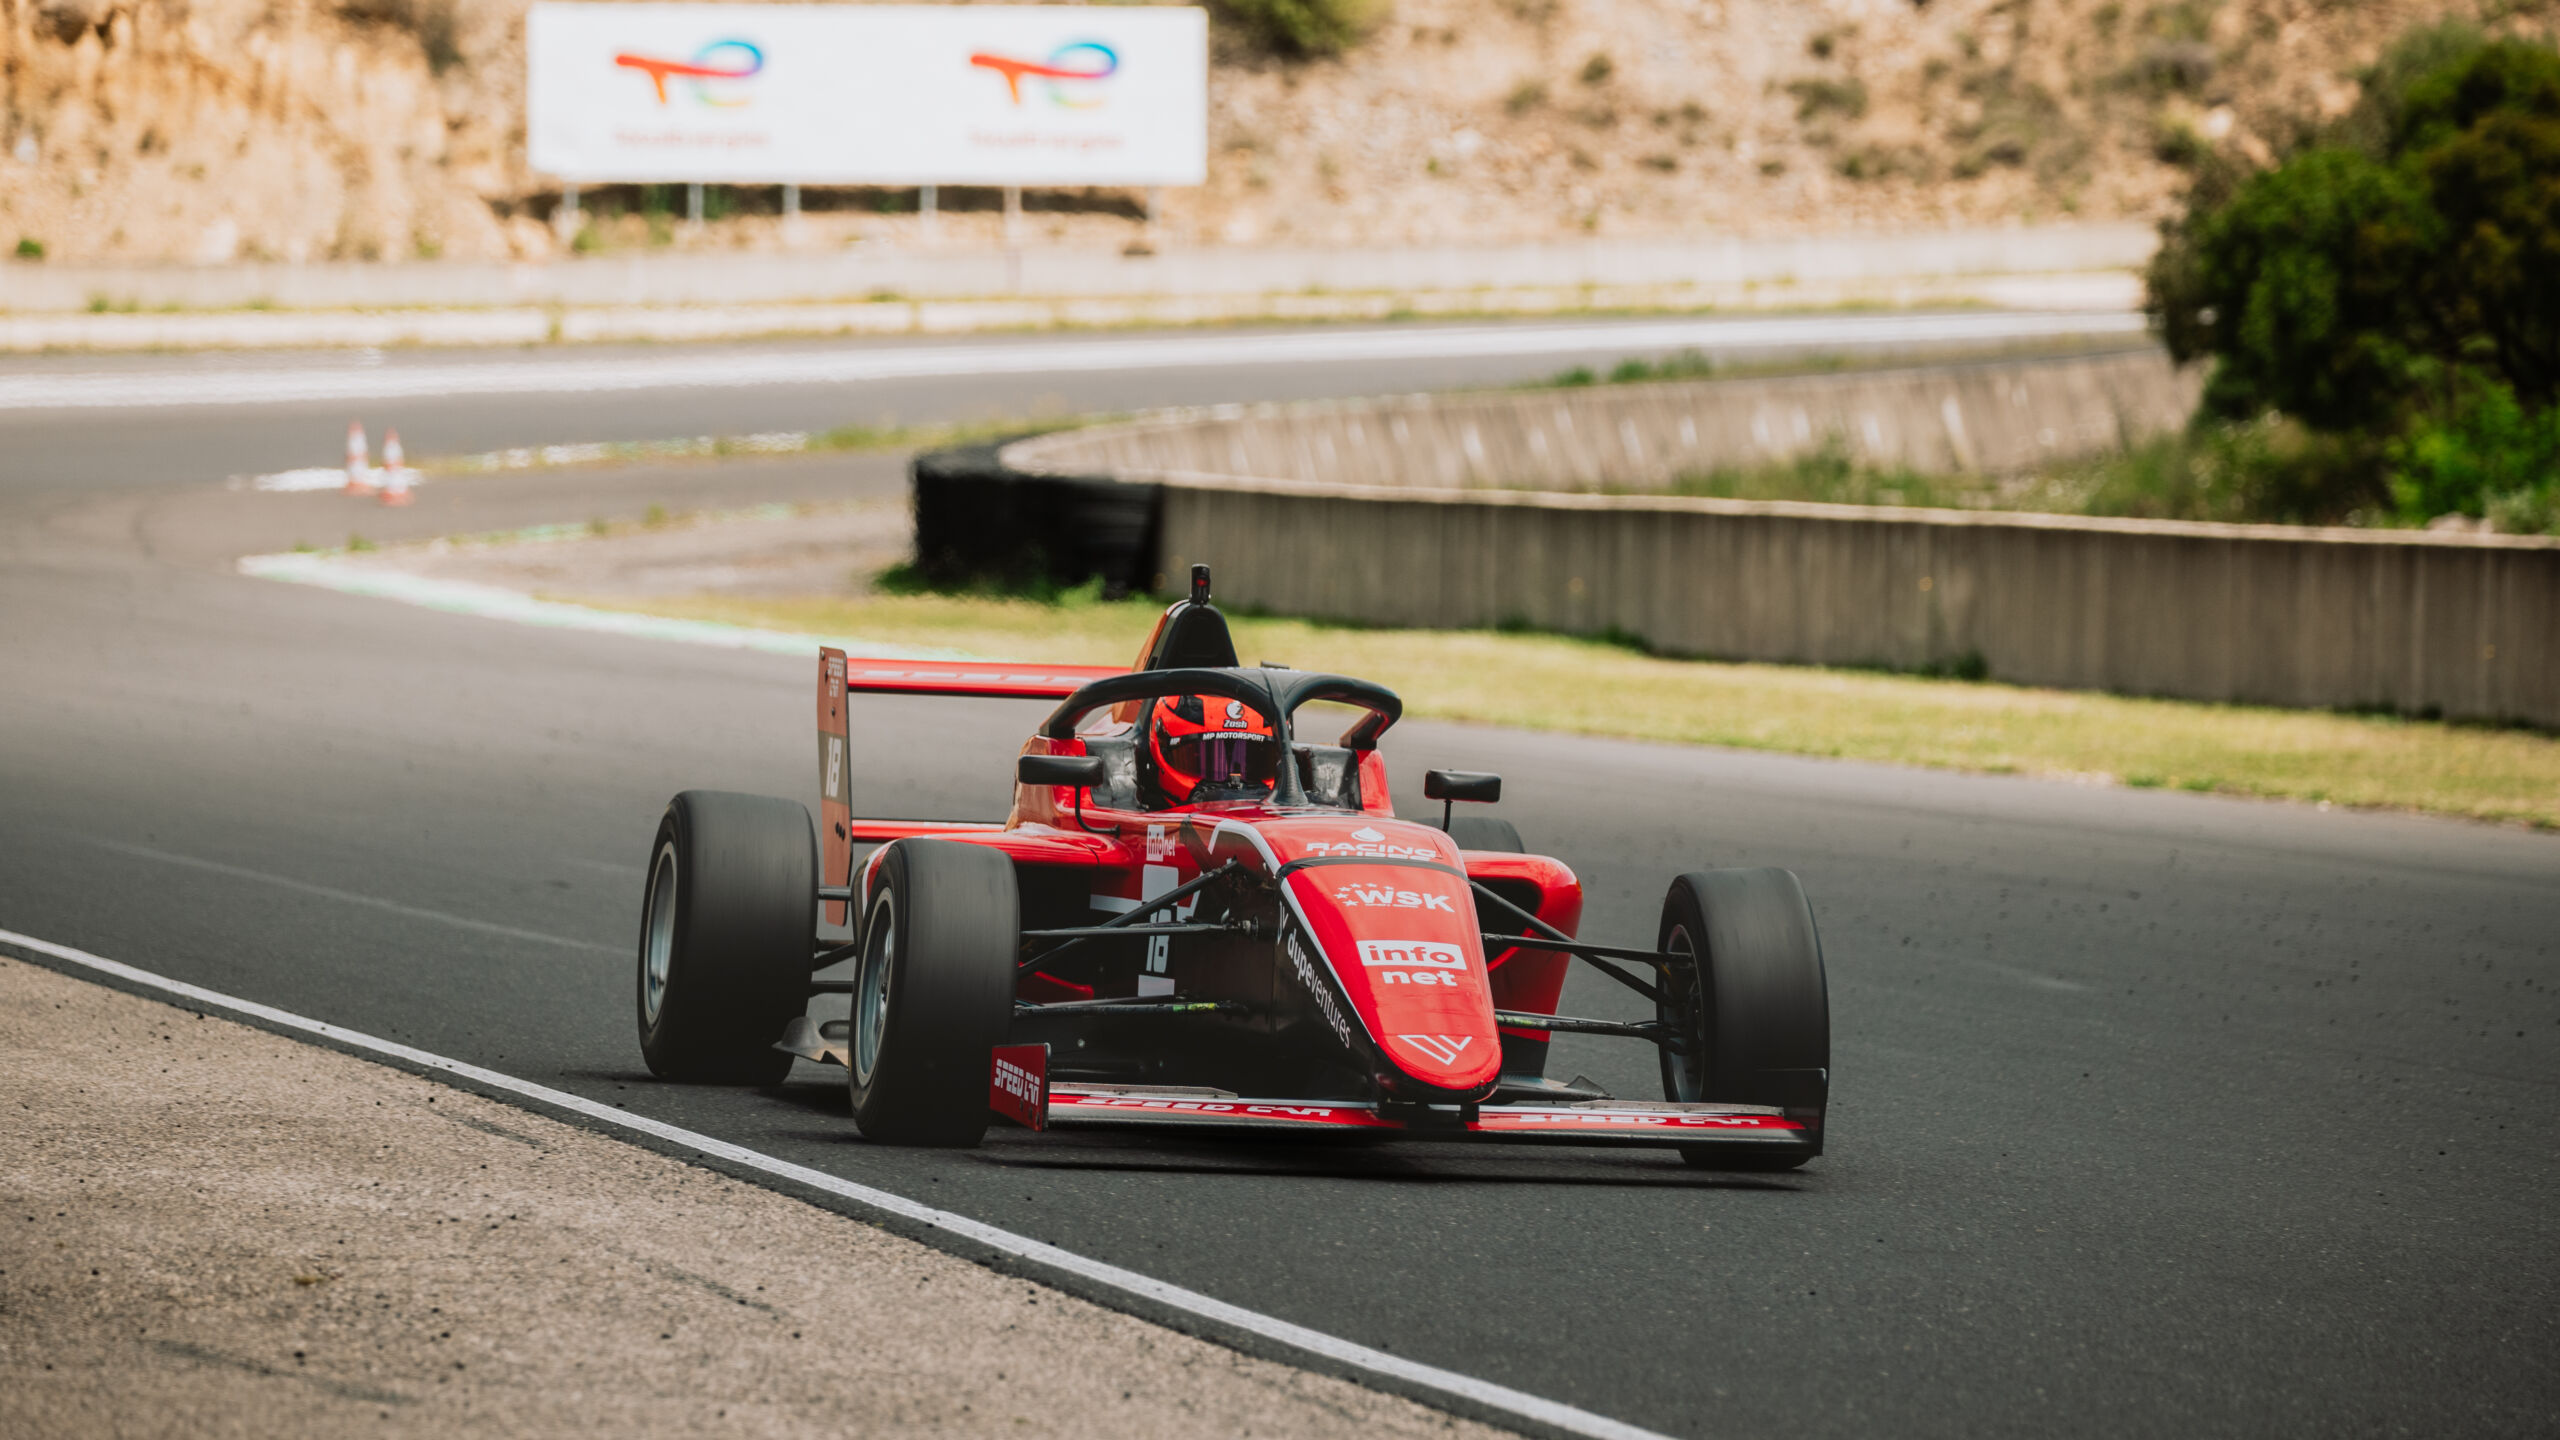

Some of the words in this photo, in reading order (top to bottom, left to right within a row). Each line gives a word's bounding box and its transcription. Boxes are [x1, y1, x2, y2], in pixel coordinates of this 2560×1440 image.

[1202, 732, 1215, 740] MP
[1216, 732, 1265, 742] MOTORSPORT
[825, 737, 841, 797] 18
[1306, 842, 1436, 858] RACING
[1355, 889, 1455, 913] WSK
[1368, 945, 1456, 964] info
[1382, 970, 1458, 987] net
[1287, 928, 1351, 1049] dupeventures
[994, 1058, 1024, 1097] SPEED
[1077, 1099, 1235, 1111] SPEED
[1247, 1105, 1332, 1117] CAR
